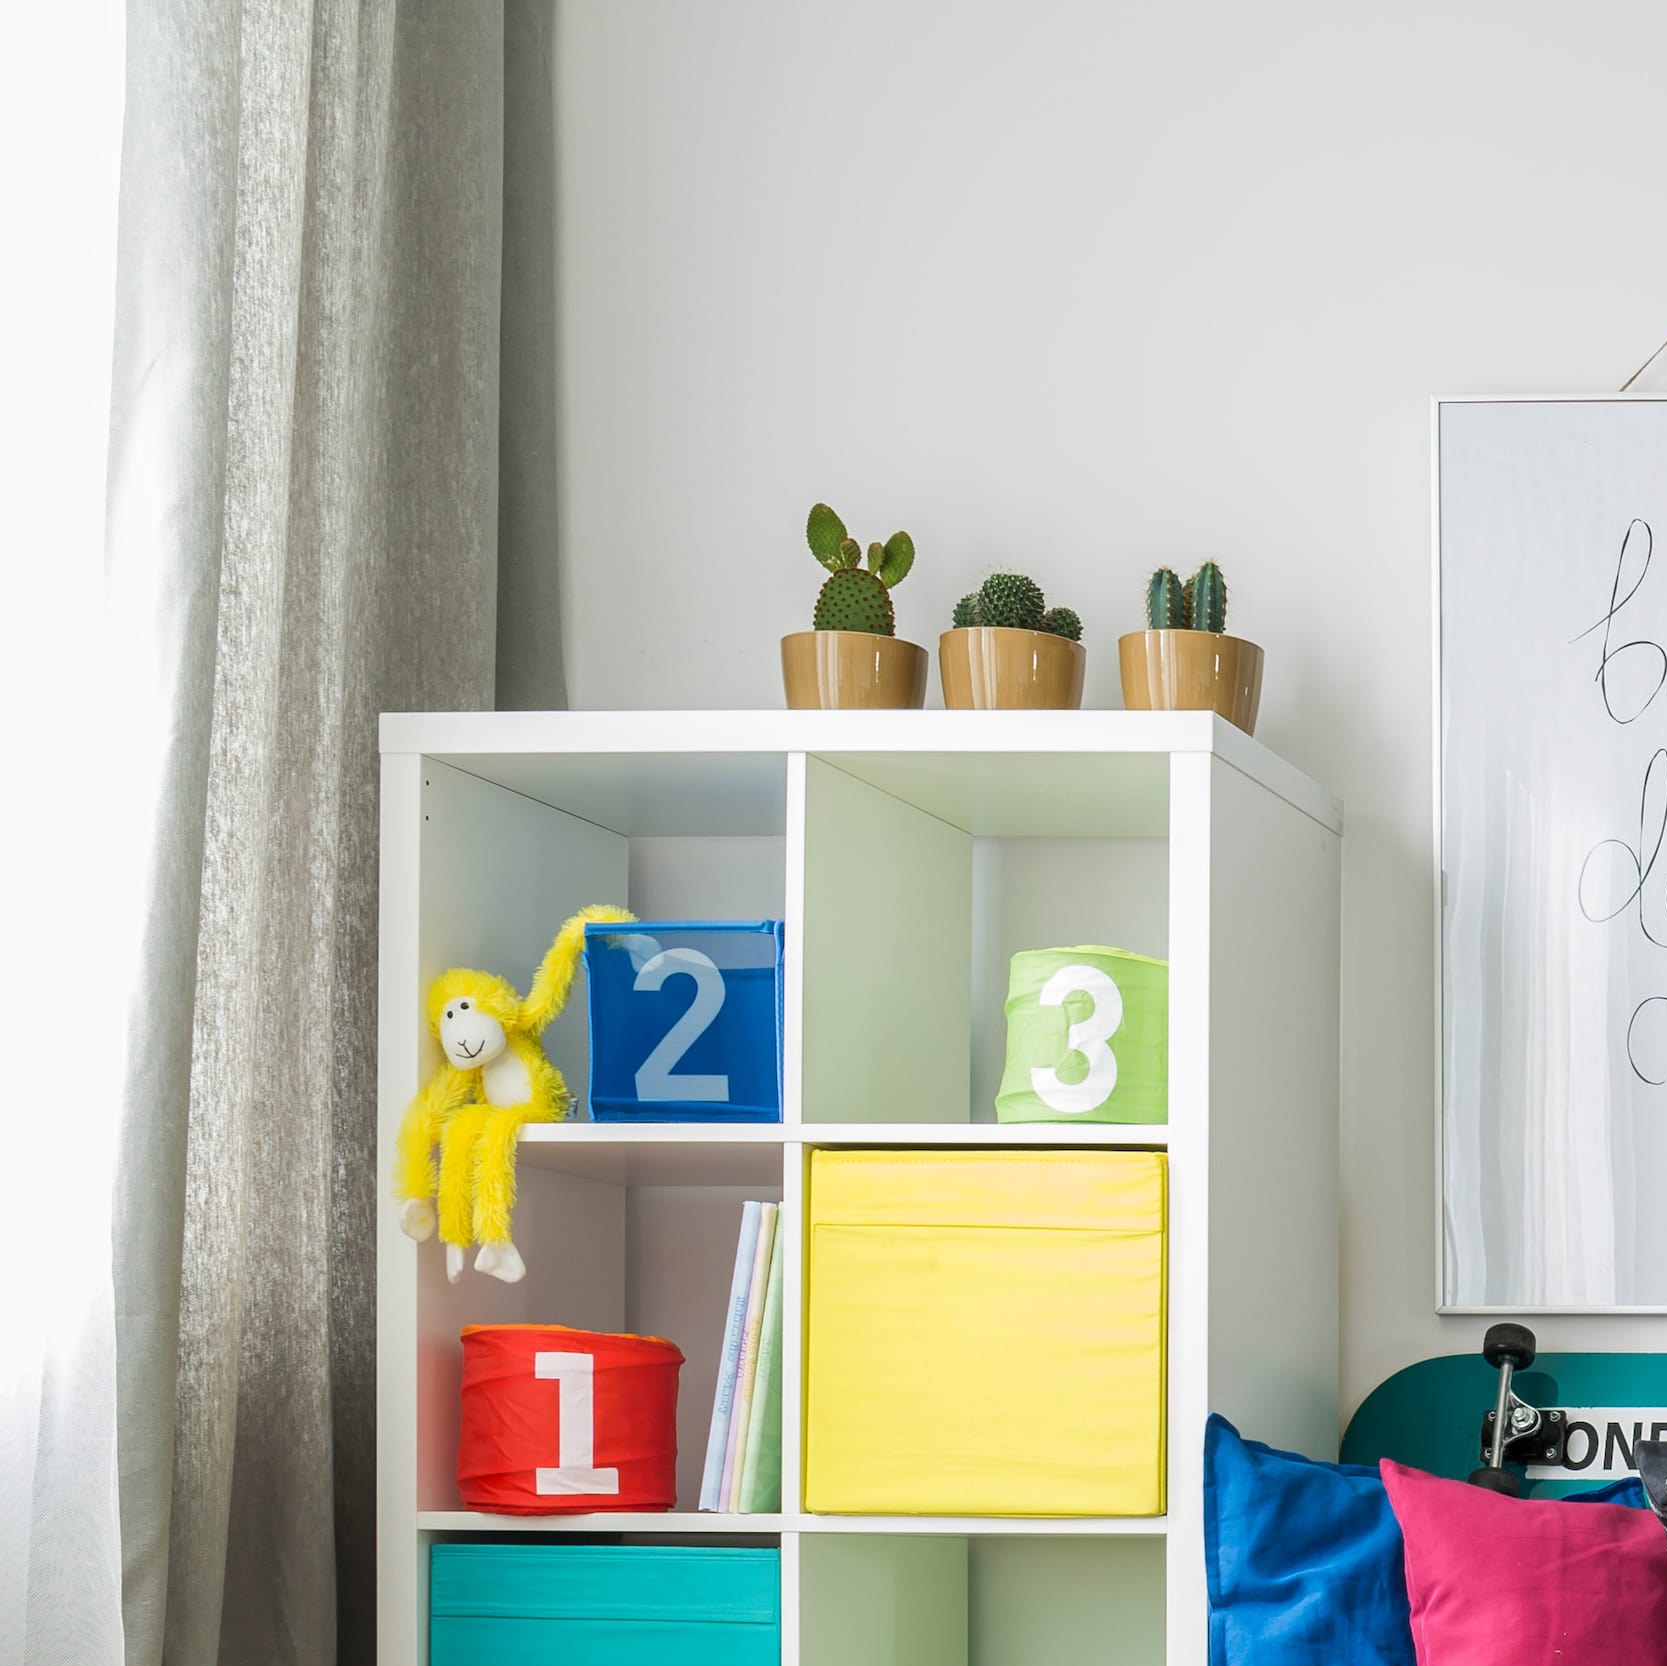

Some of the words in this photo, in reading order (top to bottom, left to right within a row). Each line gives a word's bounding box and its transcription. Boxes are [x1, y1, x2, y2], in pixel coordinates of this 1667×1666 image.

[632, 947, 730, 1103] 2
[1028, 964, 1124, 1114] 3
[534, 1350, 620, 1496] 1
